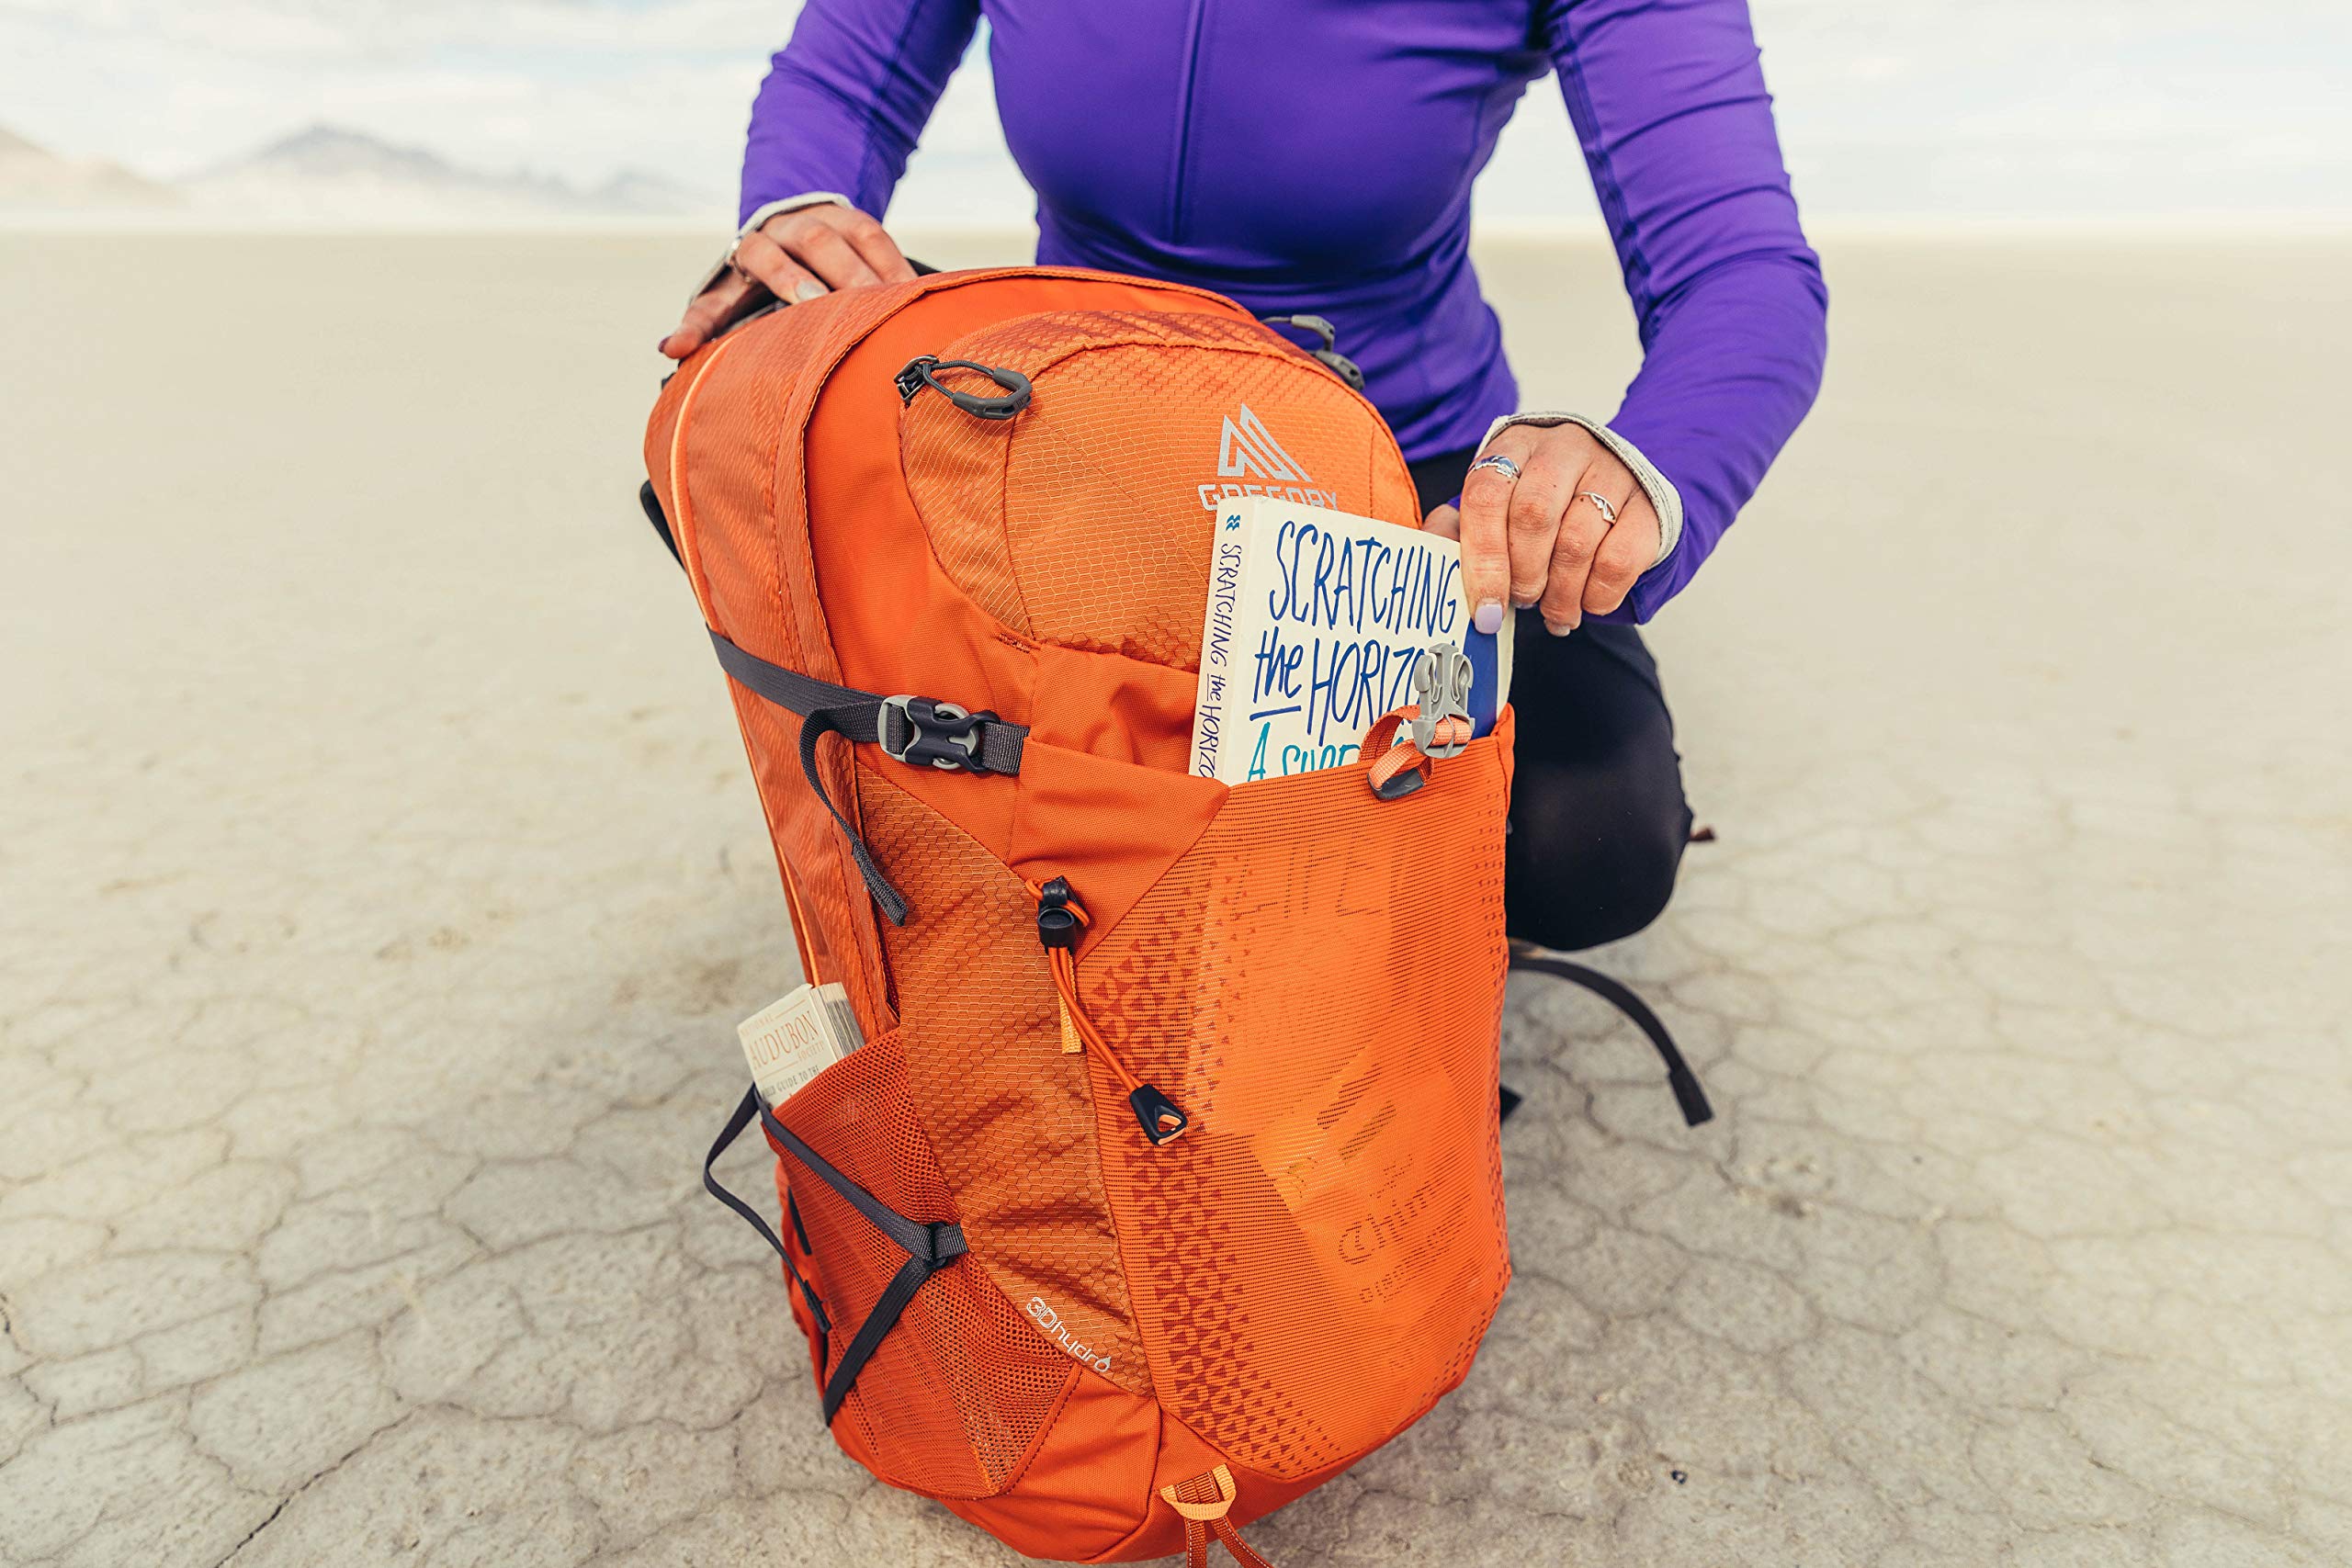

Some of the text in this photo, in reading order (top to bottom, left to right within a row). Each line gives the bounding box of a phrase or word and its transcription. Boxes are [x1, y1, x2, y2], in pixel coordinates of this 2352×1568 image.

[1269, 520, 1460, 637] SCRATCHING
[1199, 543, 1242, 778] SCRATCHING the HORIZO
[1253, 626, 1455, 746] the HORIZO
[1248, 722, 1271, 782] A
[749, 1010, 820, 1071] AUDUBON
[797, 1041, 825, 1062] SOCIETY
[776, 1075, 798, 1093] GUIDE
[798, 1071, 808, 1083] TO
